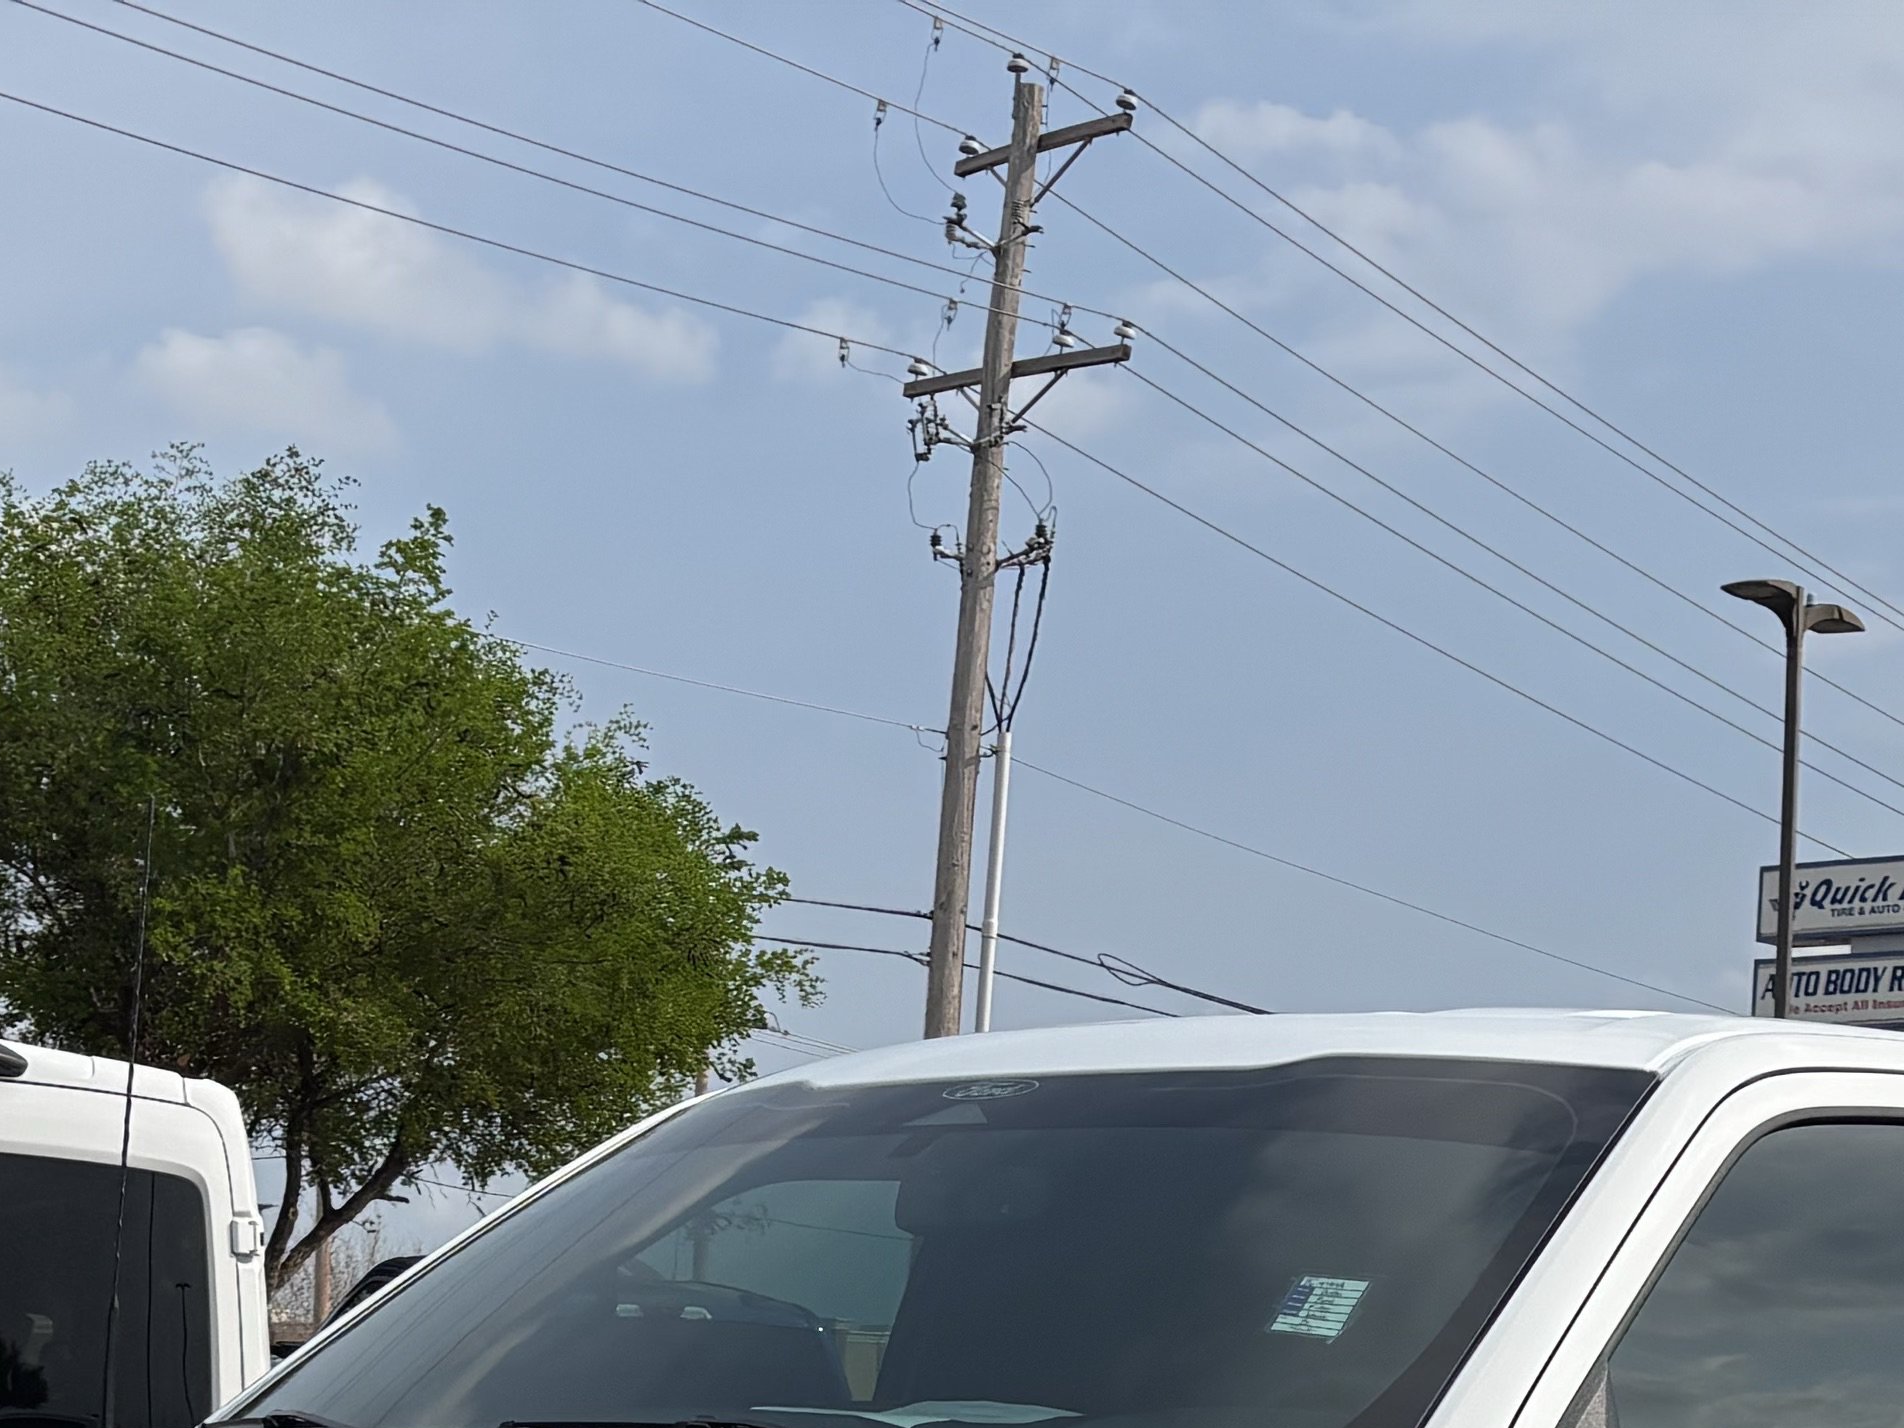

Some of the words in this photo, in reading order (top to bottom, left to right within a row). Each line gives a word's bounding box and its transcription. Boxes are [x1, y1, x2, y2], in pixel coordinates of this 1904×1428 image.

[1808, 875, 1896, 910] Quick
[1830, 906, 1856, 918] TIRE
[1857, 906, 1866, 916] &
[1868, 904, 1901, 916] AUTO
[1760, 970, 1821, 1000] ATO
[1823, 966, 1890, 997] BODY
[1803, 1001, 1849, 1015] Accept
[1851, 1000, 1869, 1012] All
